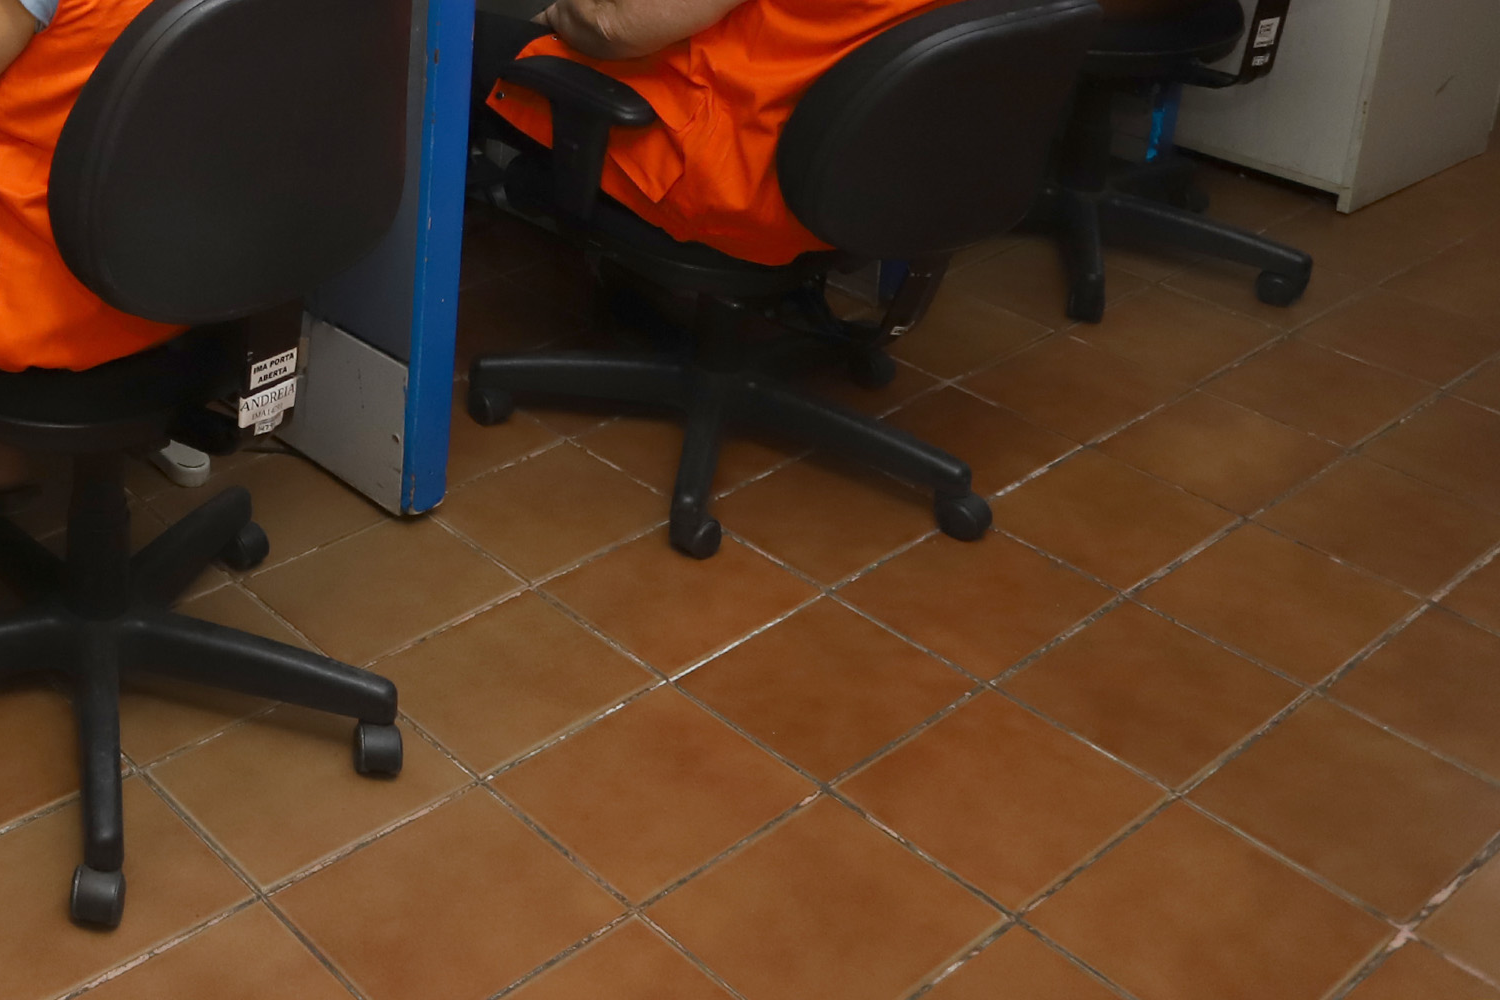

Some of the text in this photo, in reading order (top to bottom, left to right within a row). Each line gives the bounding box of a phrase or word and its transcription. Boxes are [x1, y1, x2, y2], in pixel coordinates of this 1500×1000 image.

[253, 352, 294, 375] IMA PORTA
[257, 366, 288, 384] ABERTA
[240, 383, 295, 412] ANDREIA
